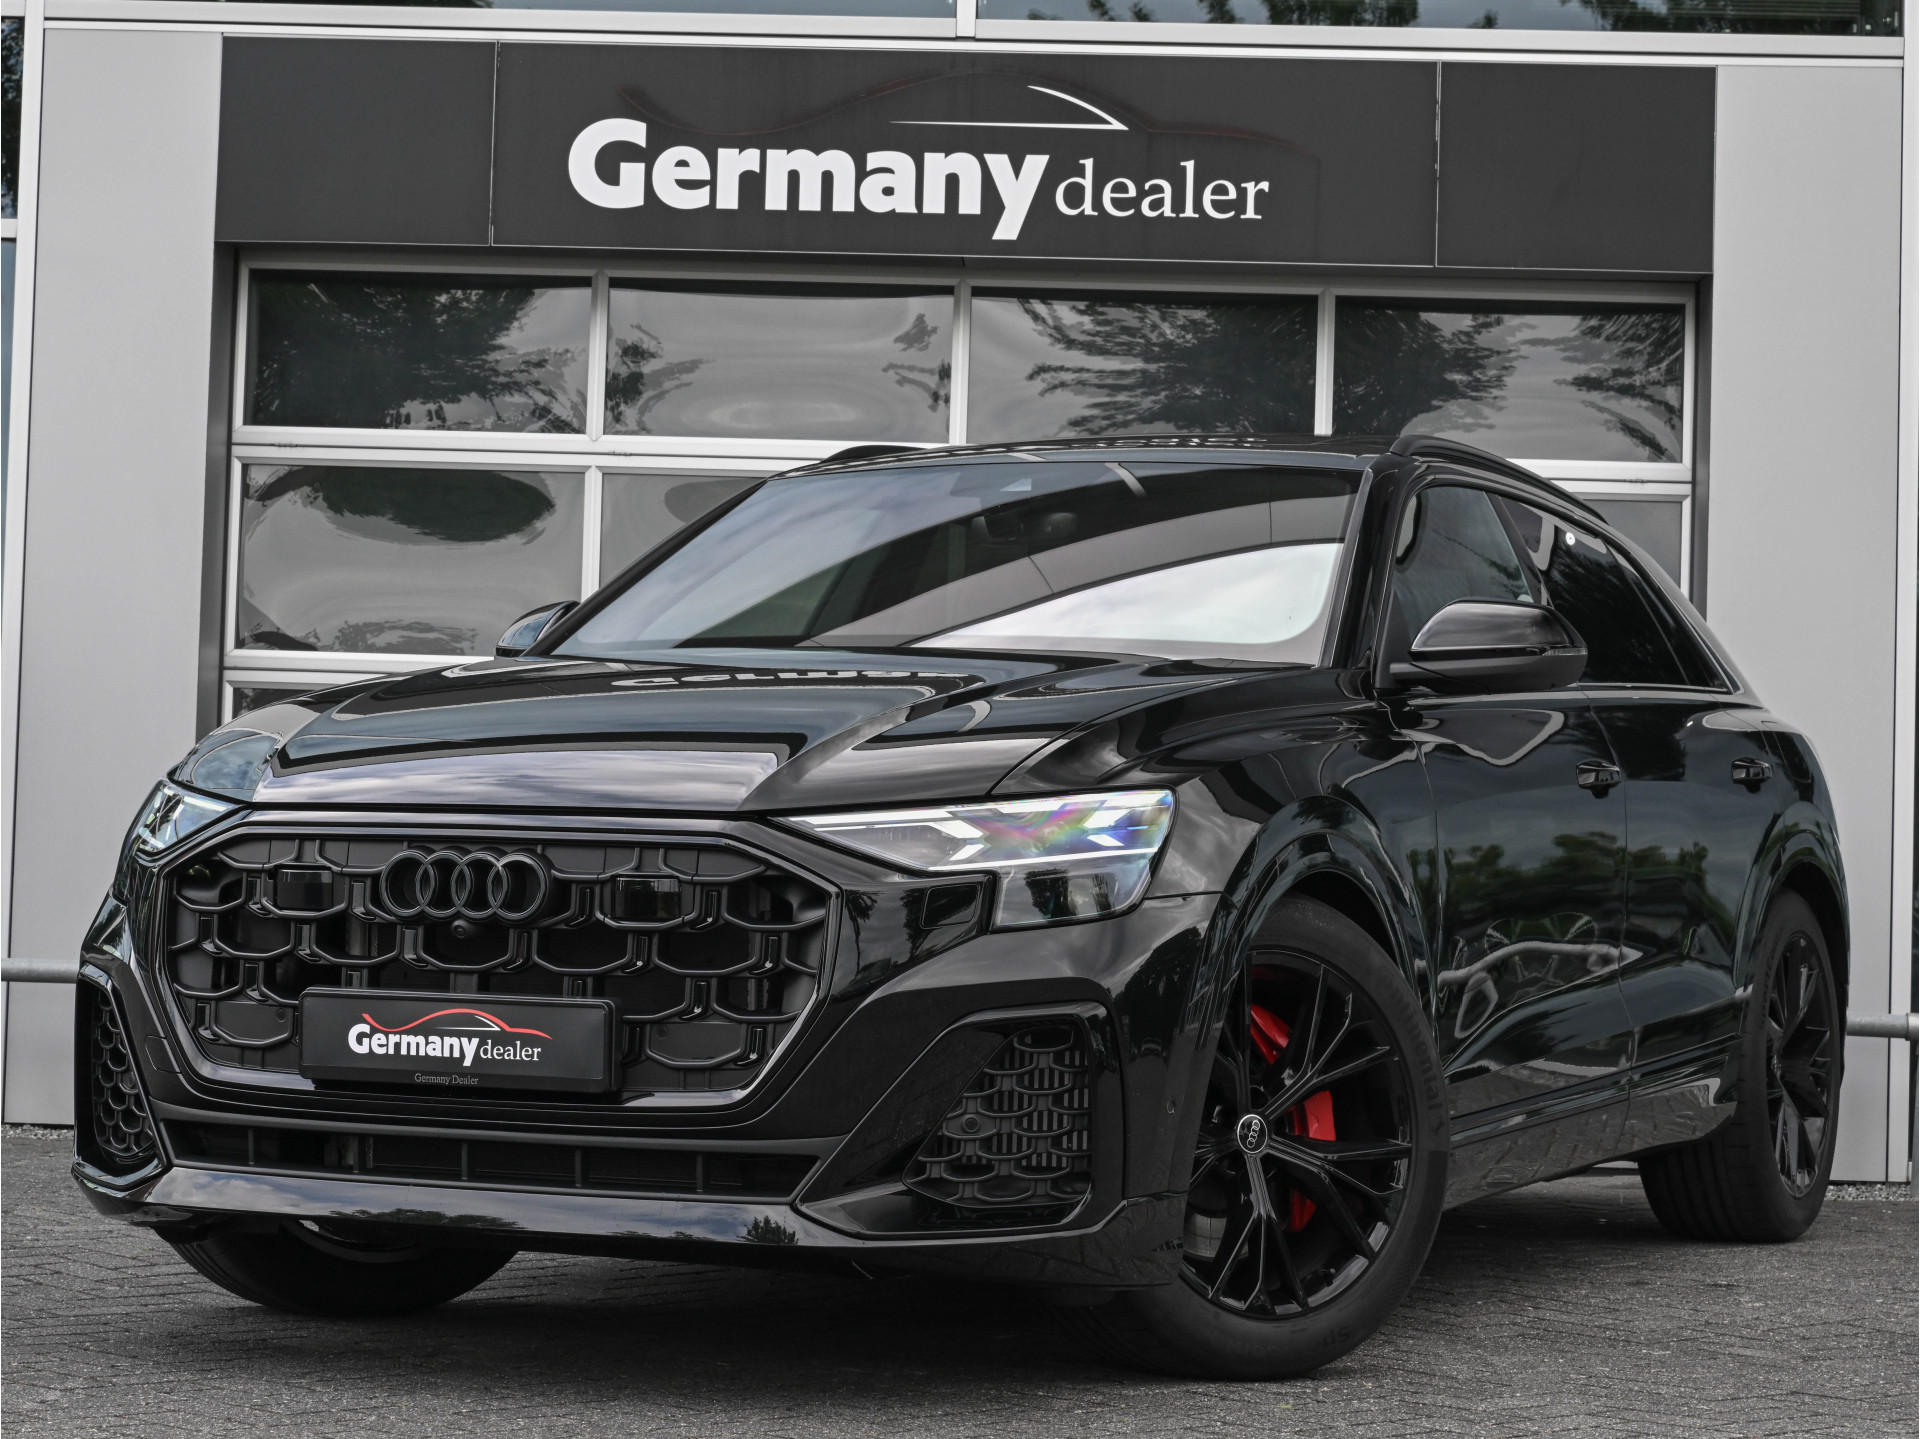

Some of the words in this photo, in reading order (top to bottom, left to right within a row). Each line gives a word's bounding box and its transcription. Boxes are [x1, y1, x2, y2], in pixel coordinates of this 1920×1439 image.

[567, 117, 1050, 241] Germany
[1055, 157, 1270, 220] dealer
[347, 1023, 480, 1067] Germany
[479, 1039, 542, 1061] dealer
[414, 1072, 451, 1086] Germany
[451, 1074, 479, 1085] Dealer
